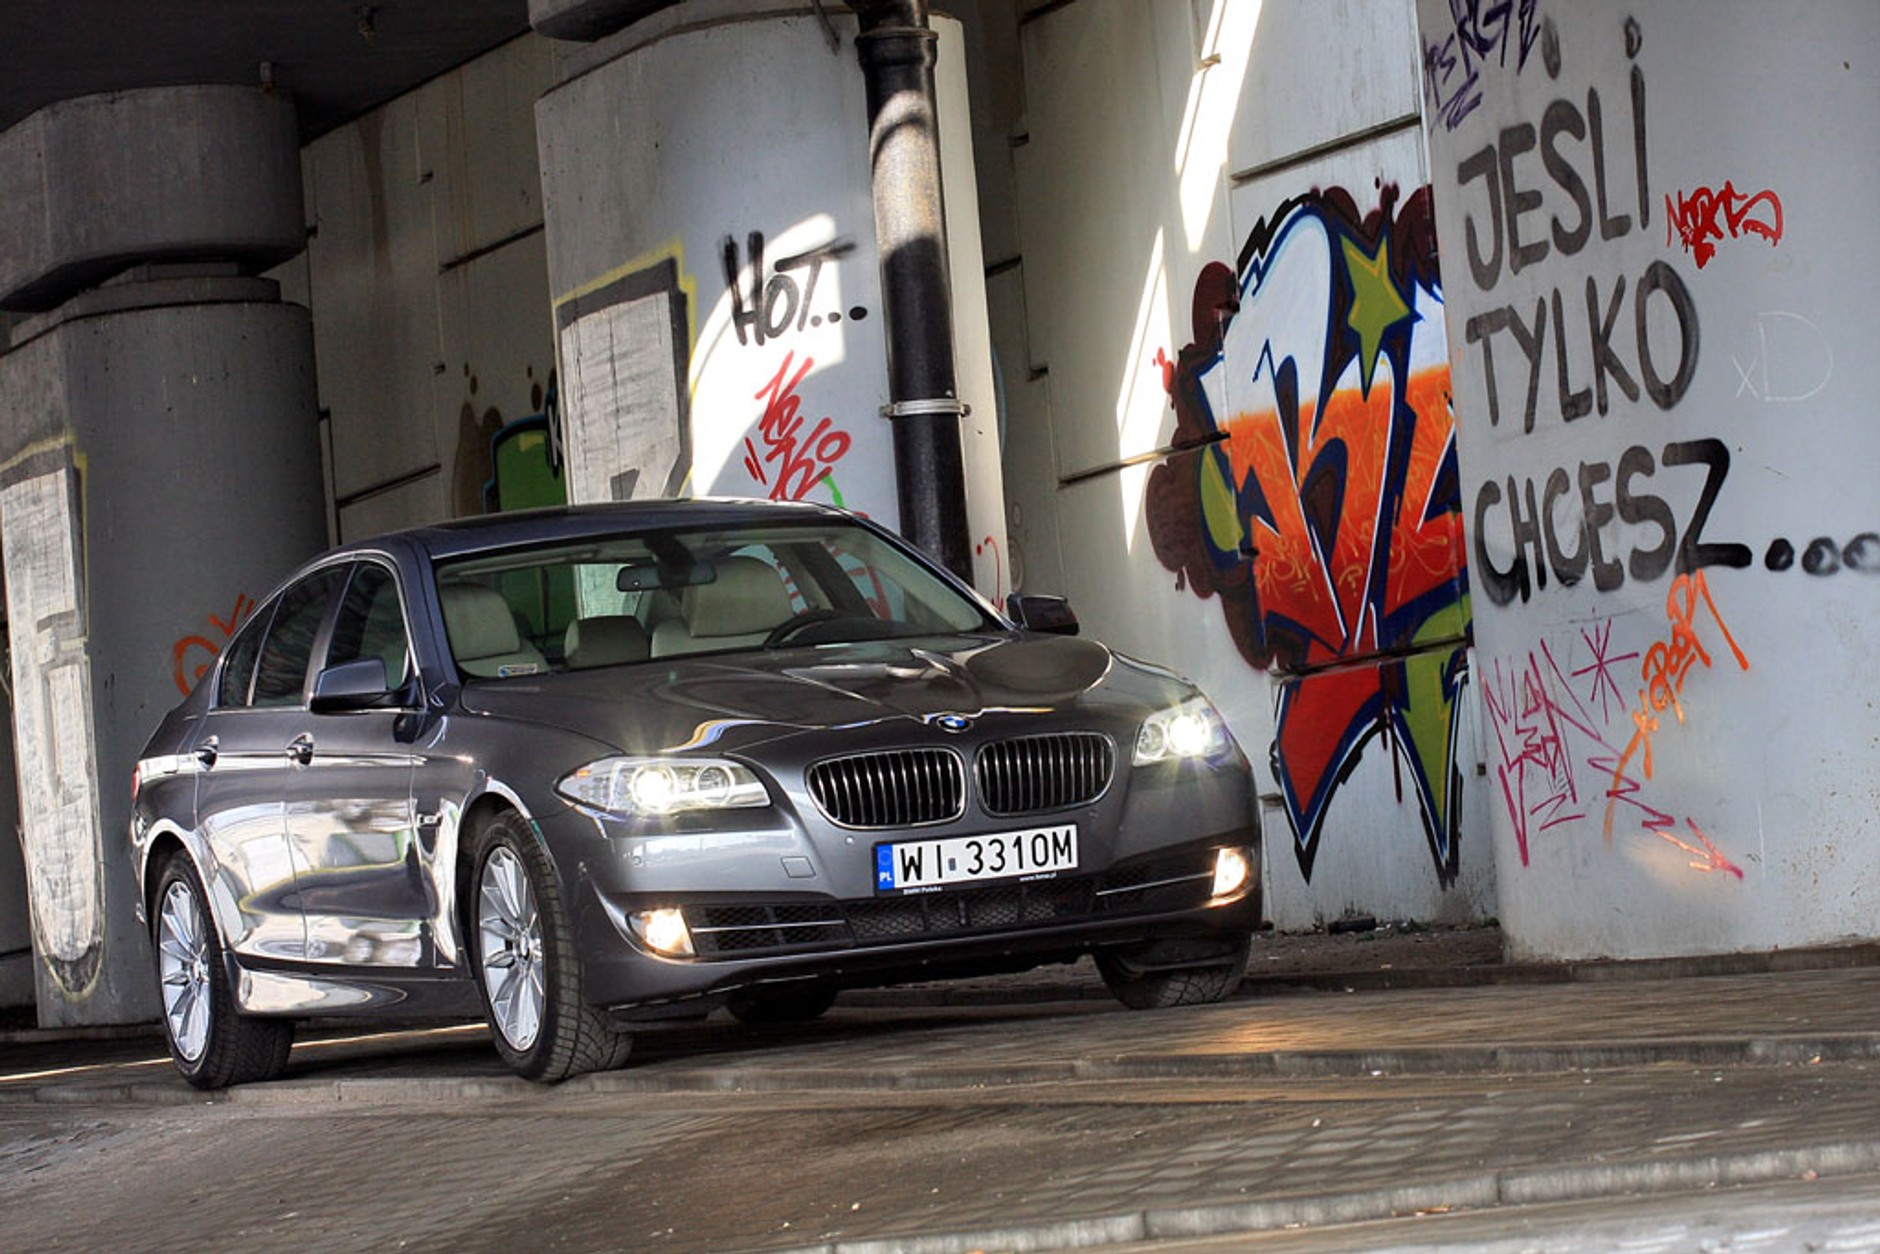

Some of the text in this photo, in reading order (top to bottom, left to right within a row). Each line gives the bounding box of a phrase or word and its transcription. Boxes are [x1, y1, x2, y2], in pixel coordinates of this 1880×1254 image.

[1466, 260, 1700, 435] TYLKO
[879, 872, 894, 882] PL
[900, 829, 1073, 882] WI 3310M
